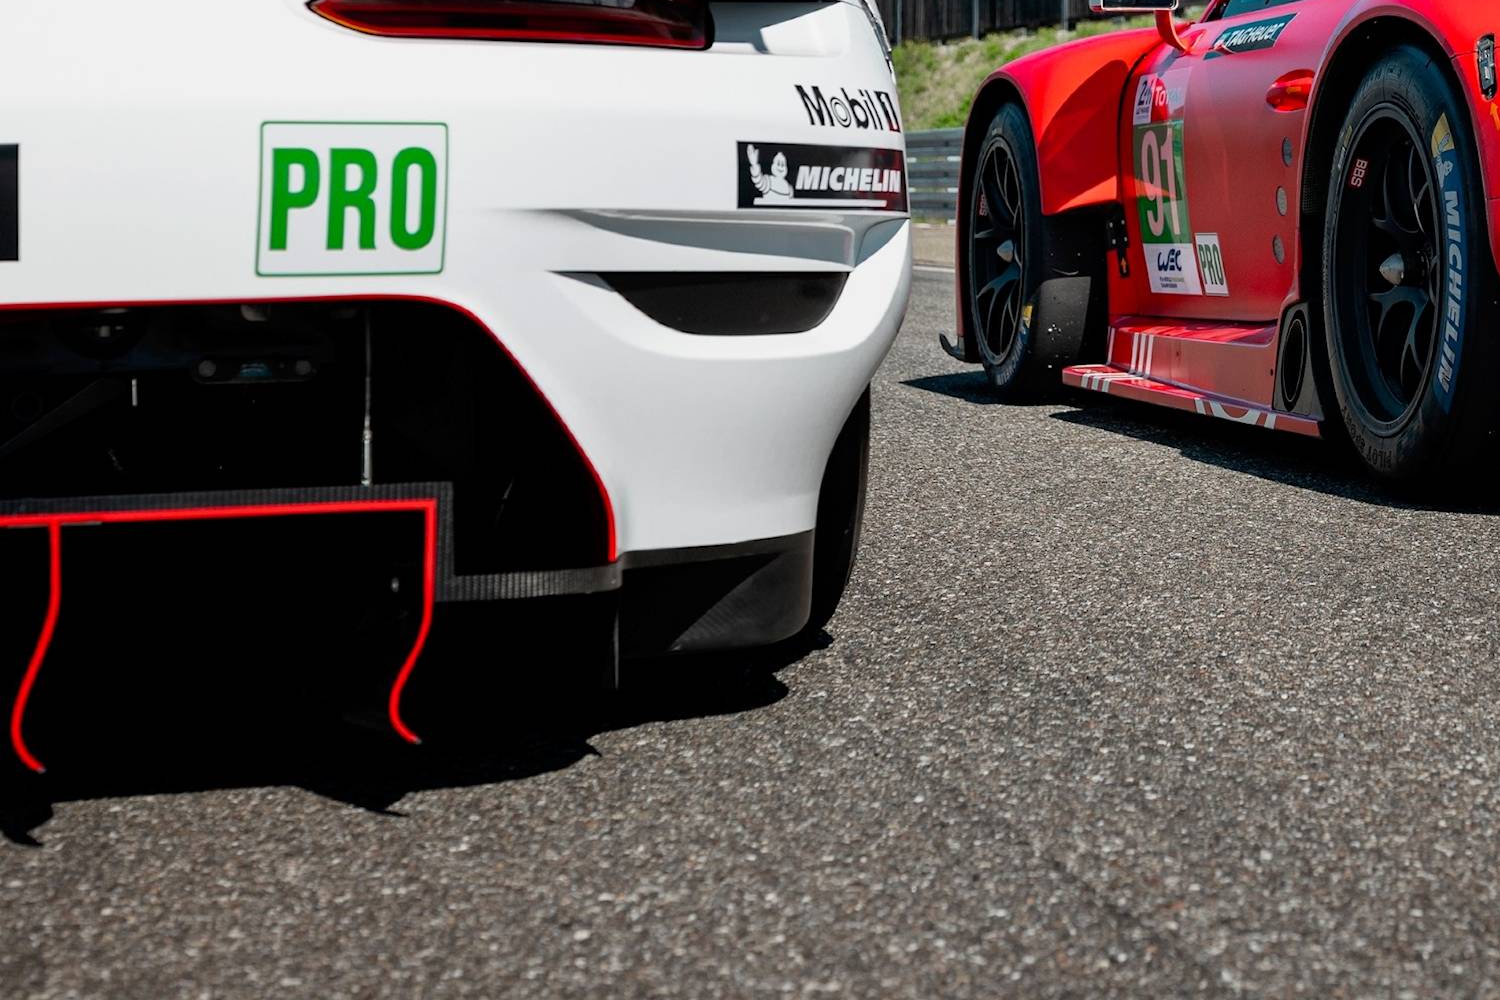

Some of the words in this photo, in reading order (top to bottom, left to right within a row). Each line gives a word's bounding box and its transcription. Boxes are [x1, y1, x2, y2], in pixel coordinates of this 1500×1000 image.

[794, 84, 884, 131] Mobil
[877, 92, 899, 132] 1
[795, 165, 901, 193] MICHELIN
[1141, 127, 1181, 237] 91
[1351, 158, 1368, 188] BBS
[268, 146, 438, 252] PRO
[1157, 247, 1182, 272] WEC
[1198, 243, 1225, 286] PRO
[1437, 190, 1463, 394] MICHELIN
